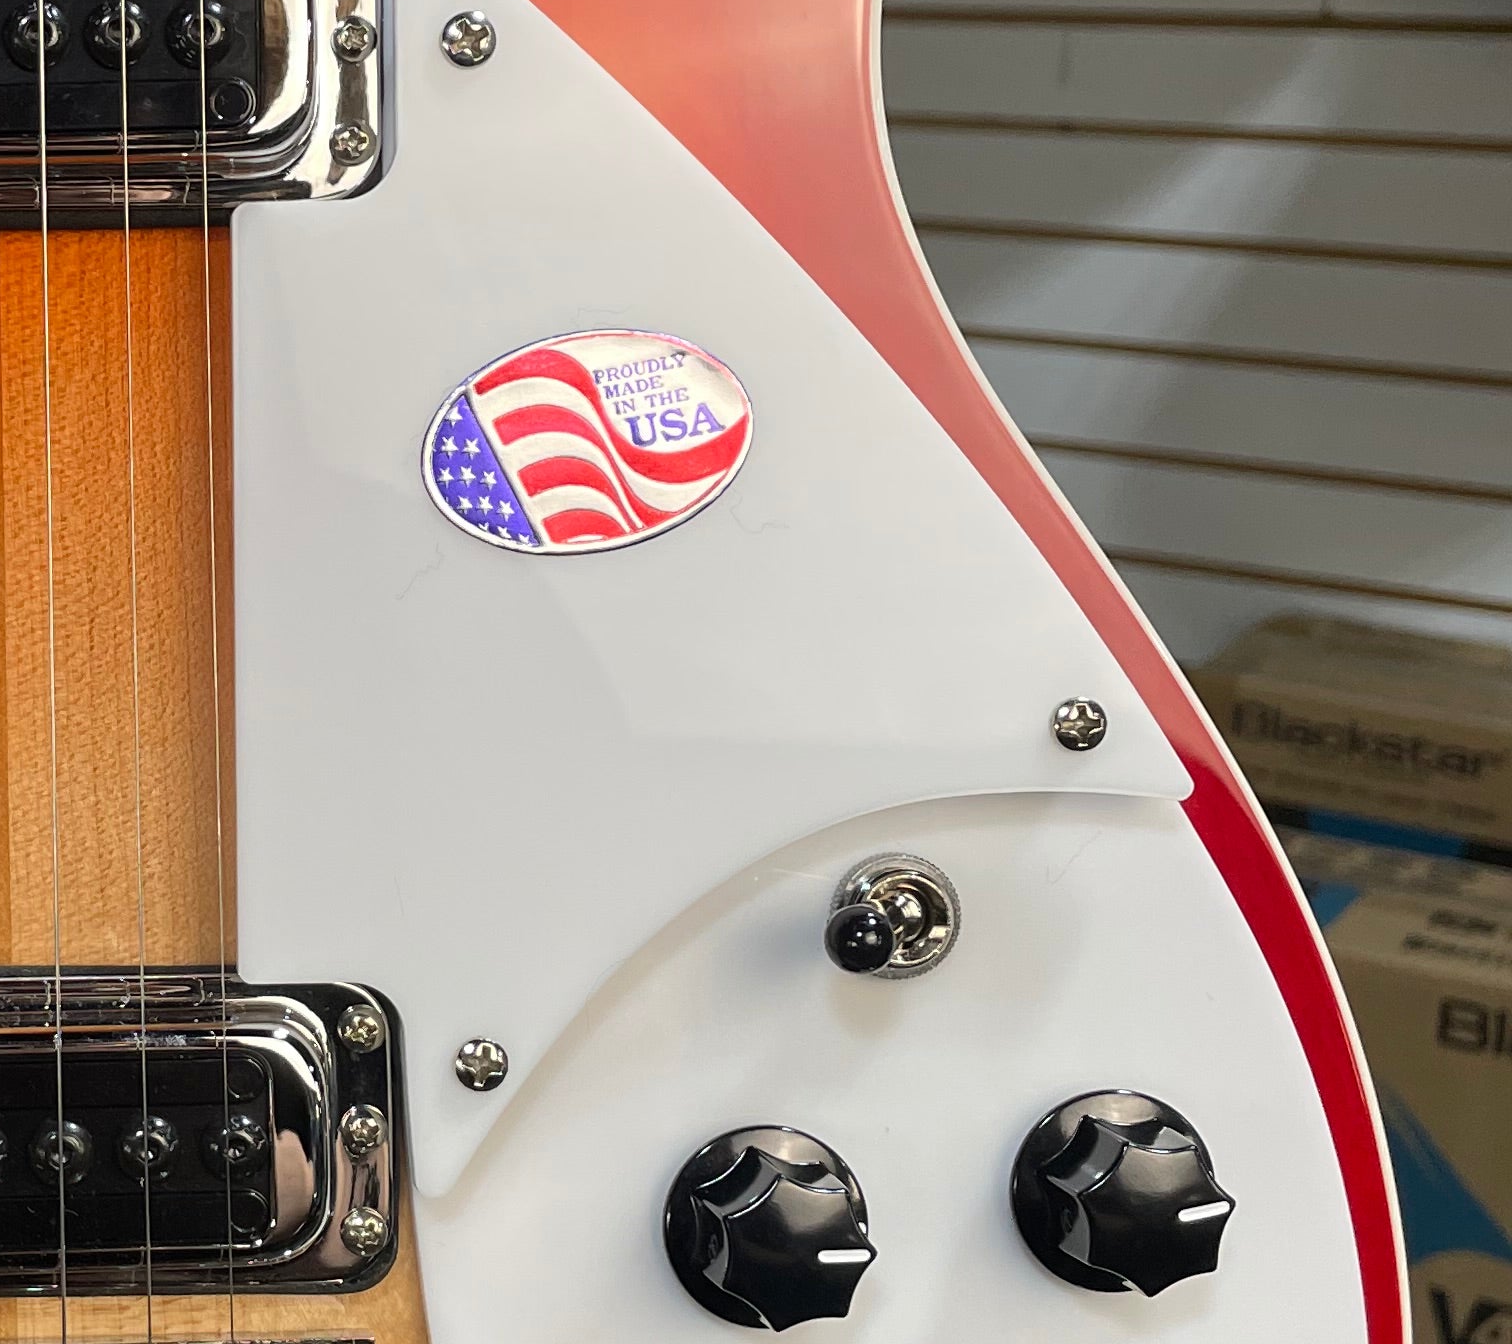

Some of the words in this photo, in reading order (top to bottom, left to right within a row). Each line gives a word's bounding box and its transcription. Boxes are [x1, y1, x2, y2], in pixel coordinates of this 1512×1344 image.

[592, 350, 687, 385] PROUDLY
[603, 375, 664, 400] MADE
[613, 398, 636, 416] IN
[644, 387, 690, 408] THE
[624, 402, 727, 447] USA
